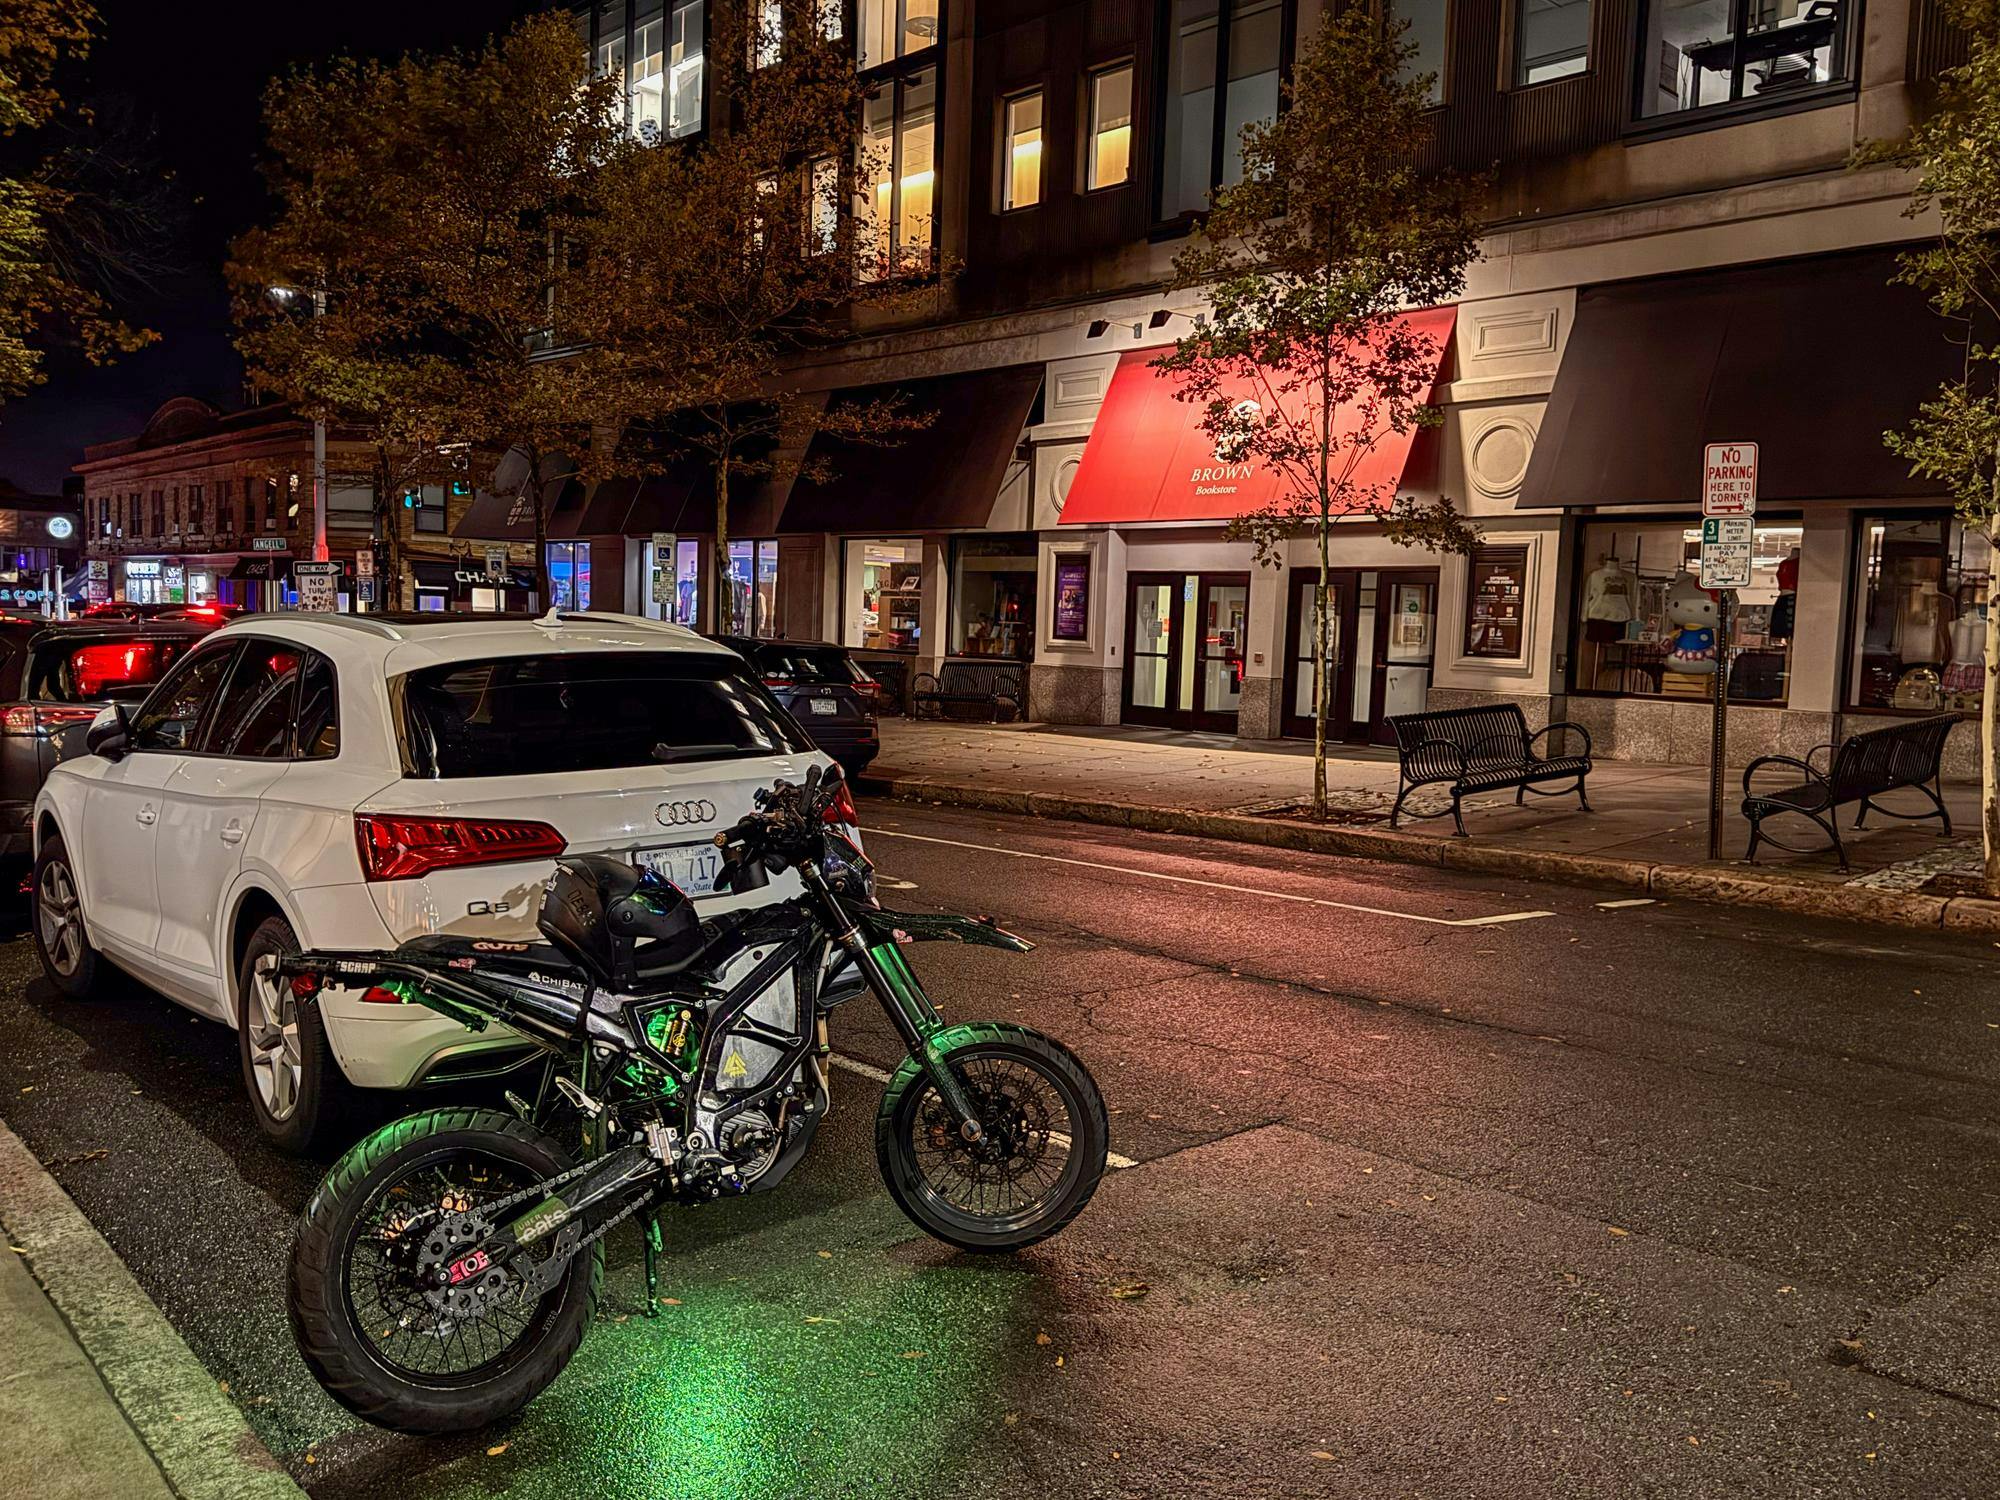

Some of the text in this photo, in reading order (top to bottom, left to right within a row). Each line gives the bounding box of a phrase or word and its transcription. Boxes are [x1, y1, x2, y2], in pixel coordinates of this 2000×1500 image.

[1721, 449, 1741, 463] NO
[1190, 465, 1255, 482] BROWN
[1708, 465, 1753, 480] PARKING
[1195, 484, 1238, 496] Bookstore
[1710, 481, 1751, 492] HERE TO
[1711, 493, 1749, 503] CORNER
[1707, 521, 1715, 535] 3
[255, 540, 279, 549] ANGELL
[309, 578, 325, 586] NO
[454, 571, 516, 584] CHAE
[684, 856, 716, 881] 717
[691, 883, 712, 893] State
[467, 901, 510, 916] Q5
[518, 1214, 542, 1231] UBER
[523, 1210, 567, 1241] eats
